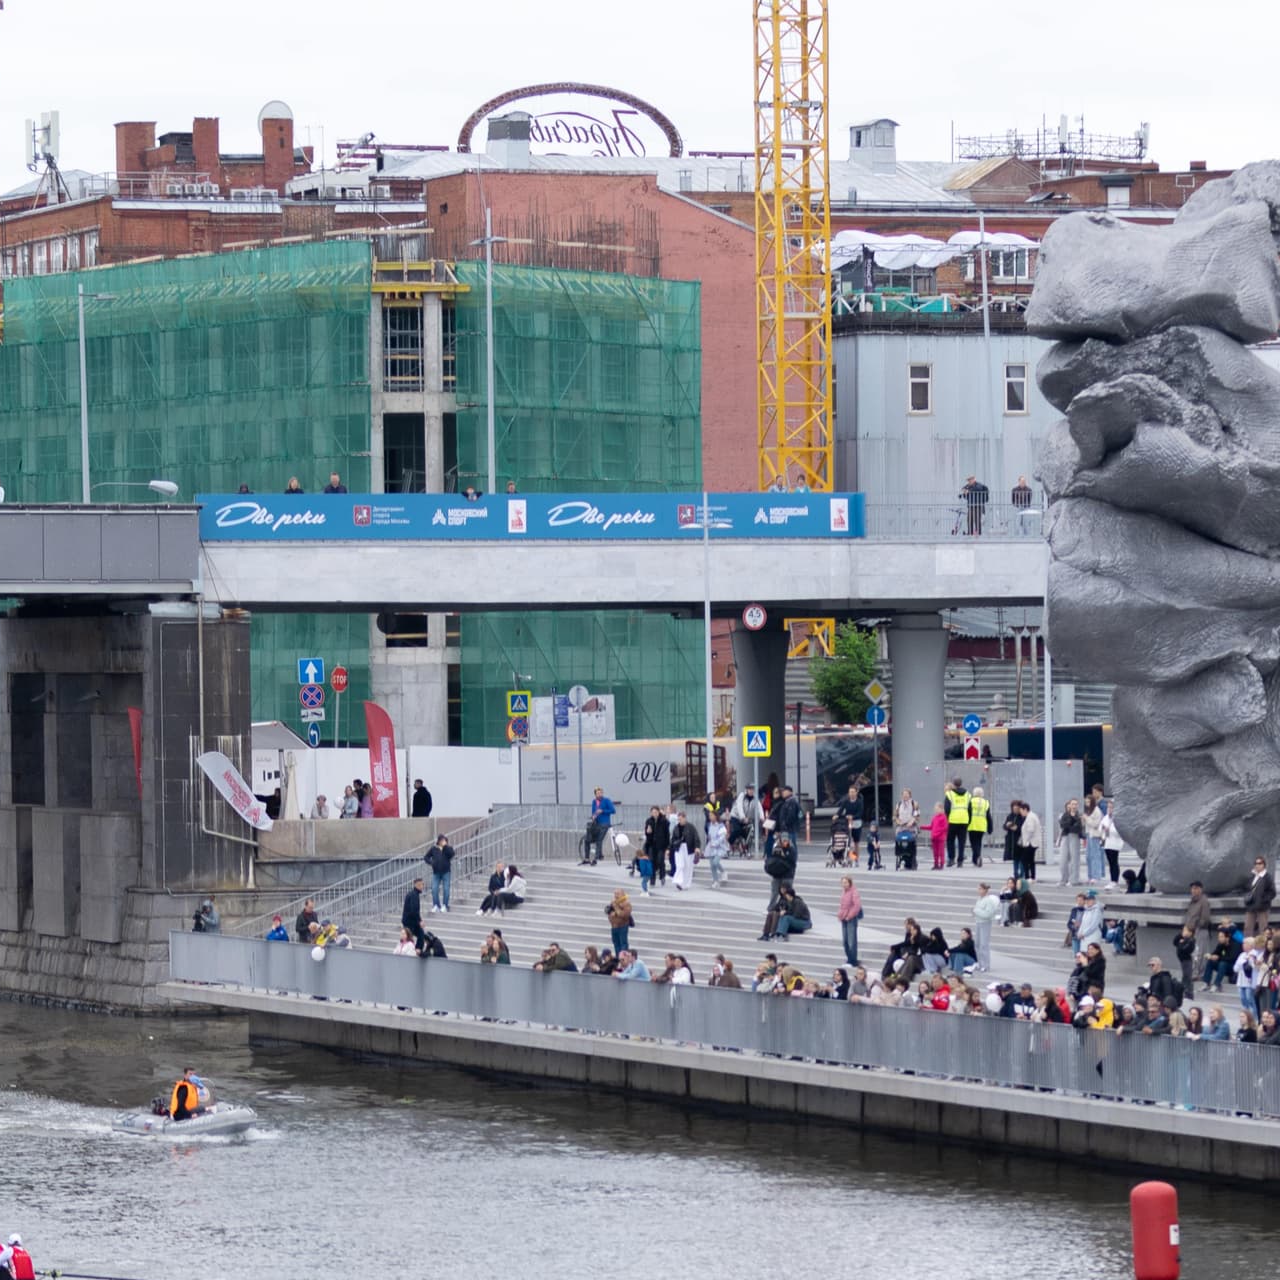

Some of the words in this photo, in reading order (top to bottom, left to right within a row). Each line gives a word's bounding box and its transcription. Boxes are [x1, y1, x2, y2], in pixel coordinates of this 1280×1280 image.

[272, 509, 326, 531] реки
[602, 509, 656, 531] реки
[332, 675, 347, 685] STOP
